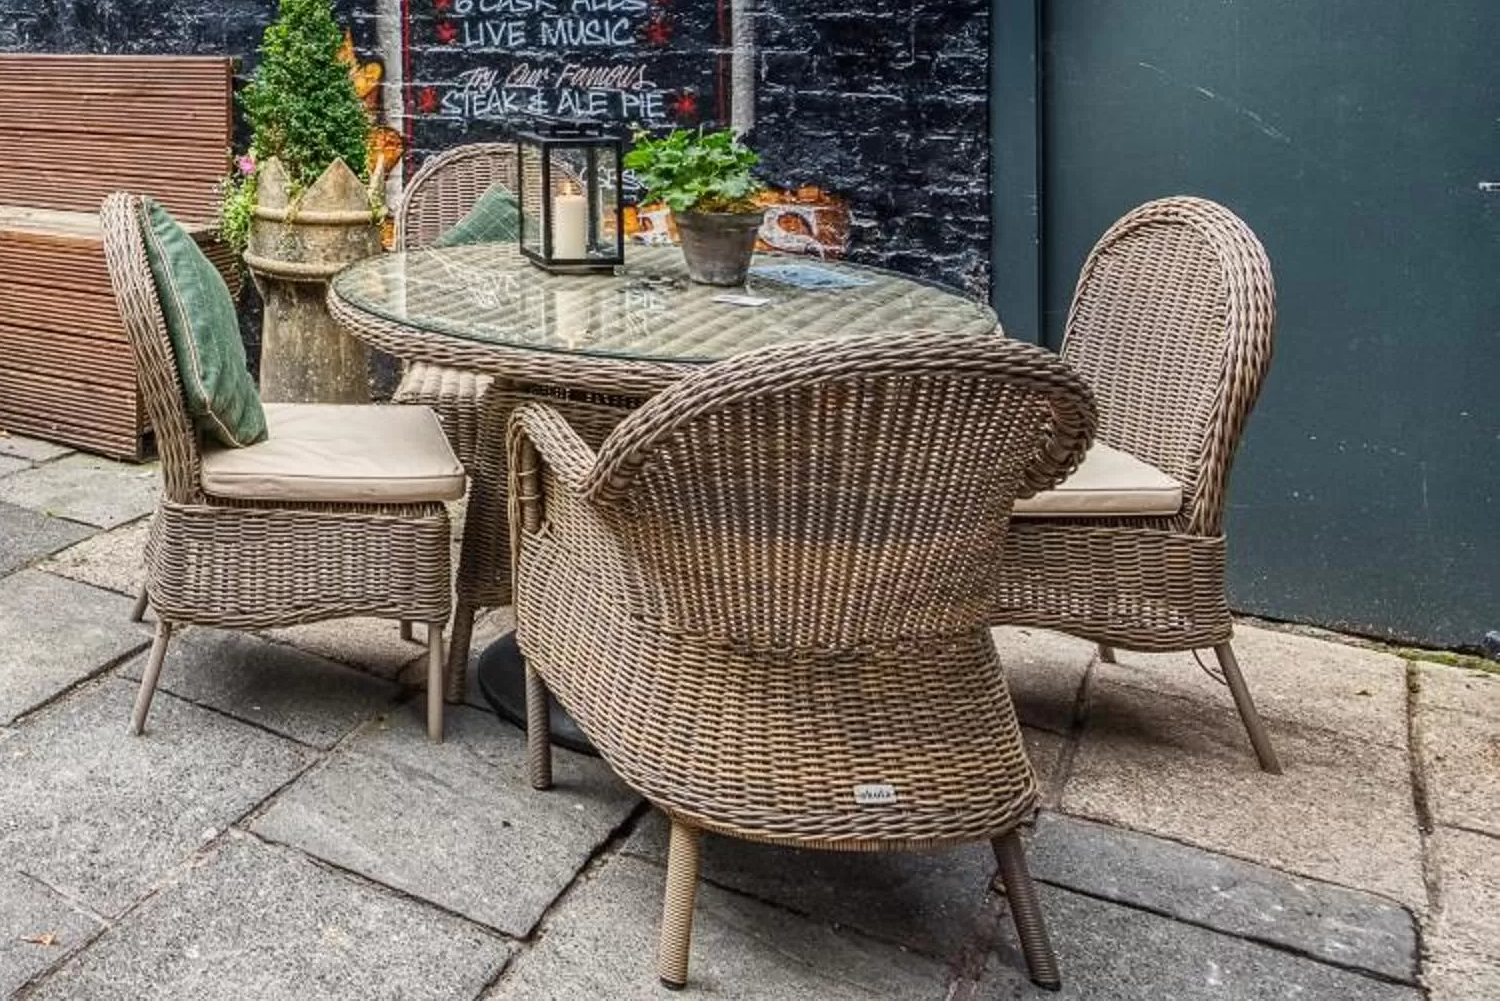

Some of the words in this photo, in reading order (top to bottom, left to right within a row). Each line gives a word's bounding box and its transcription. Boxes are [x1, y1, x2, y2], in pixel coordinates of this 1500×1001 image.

[463, 19, 526, 48] LIVE
[540, 17, 636, 47] MUSIC
[439, 91, 520, 117] STEAK
[556, 90, 607, 116] ALE
[620, 89, 667, 118] PIE
